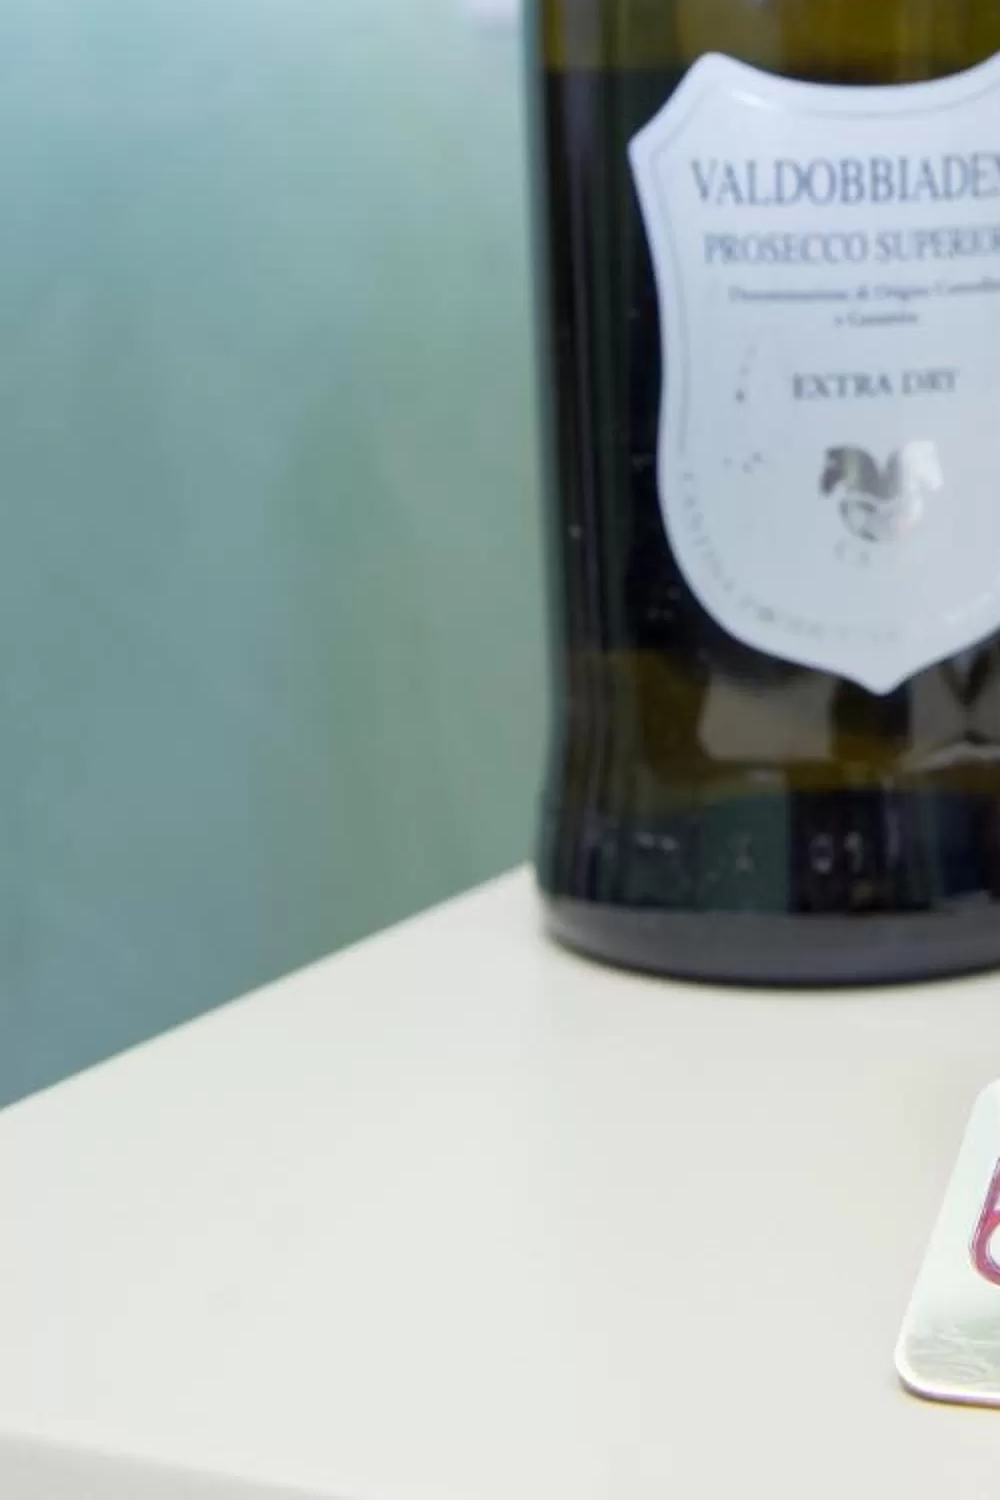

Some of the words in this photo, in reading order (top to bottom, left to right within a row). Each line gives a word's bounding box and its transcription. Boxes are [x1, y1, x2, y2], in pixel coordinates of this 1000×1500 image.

[703, 230, 870, 265] PROSECCO
[792, 370, 895, 401] EXTRA
[901, 365, 961, 397] DRY
